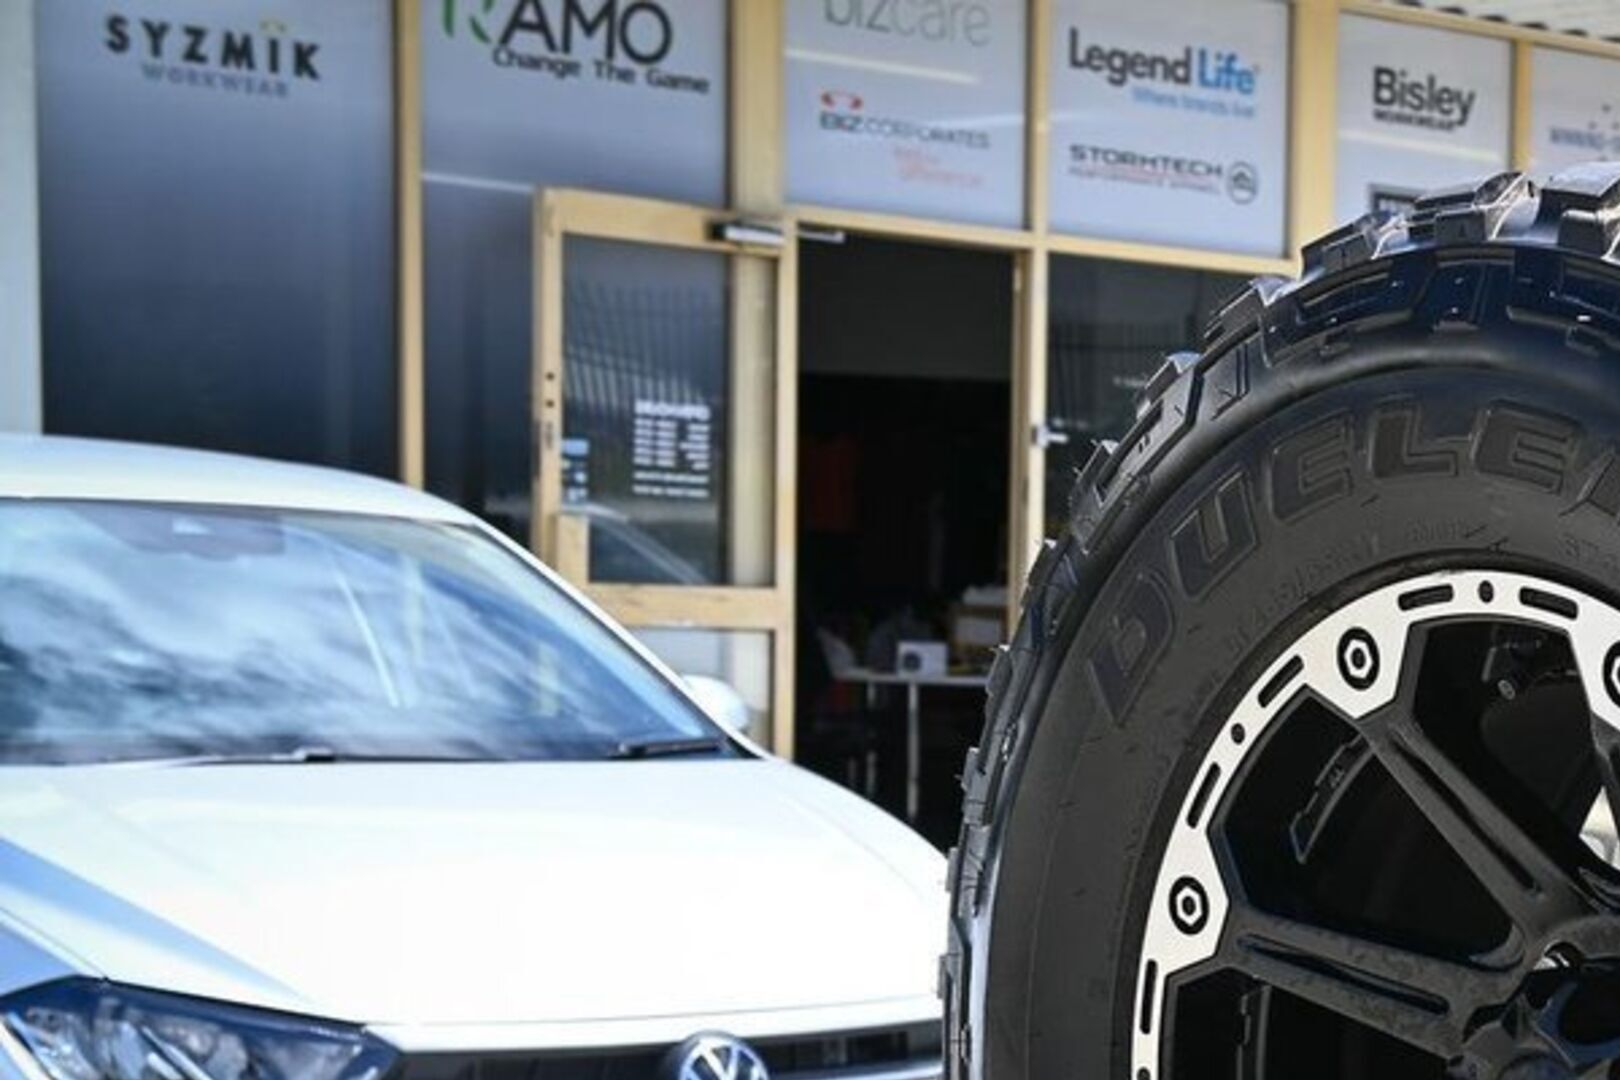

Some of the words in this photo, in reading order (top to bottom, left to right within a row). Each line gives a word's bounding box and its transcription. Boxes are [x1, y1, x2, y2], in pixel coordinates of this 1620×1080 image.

[493, 47, 580, 80] Change
[594, 59, 636, 84] The
[645, 68, 710, 95] Game
[1069, 26, 1192, 86] Legend
[1197, 48, 1255, 94] Life
[1373, 66, 1476, 126] Bisley
[1069, 144, 1223, 177] STORMTECH
